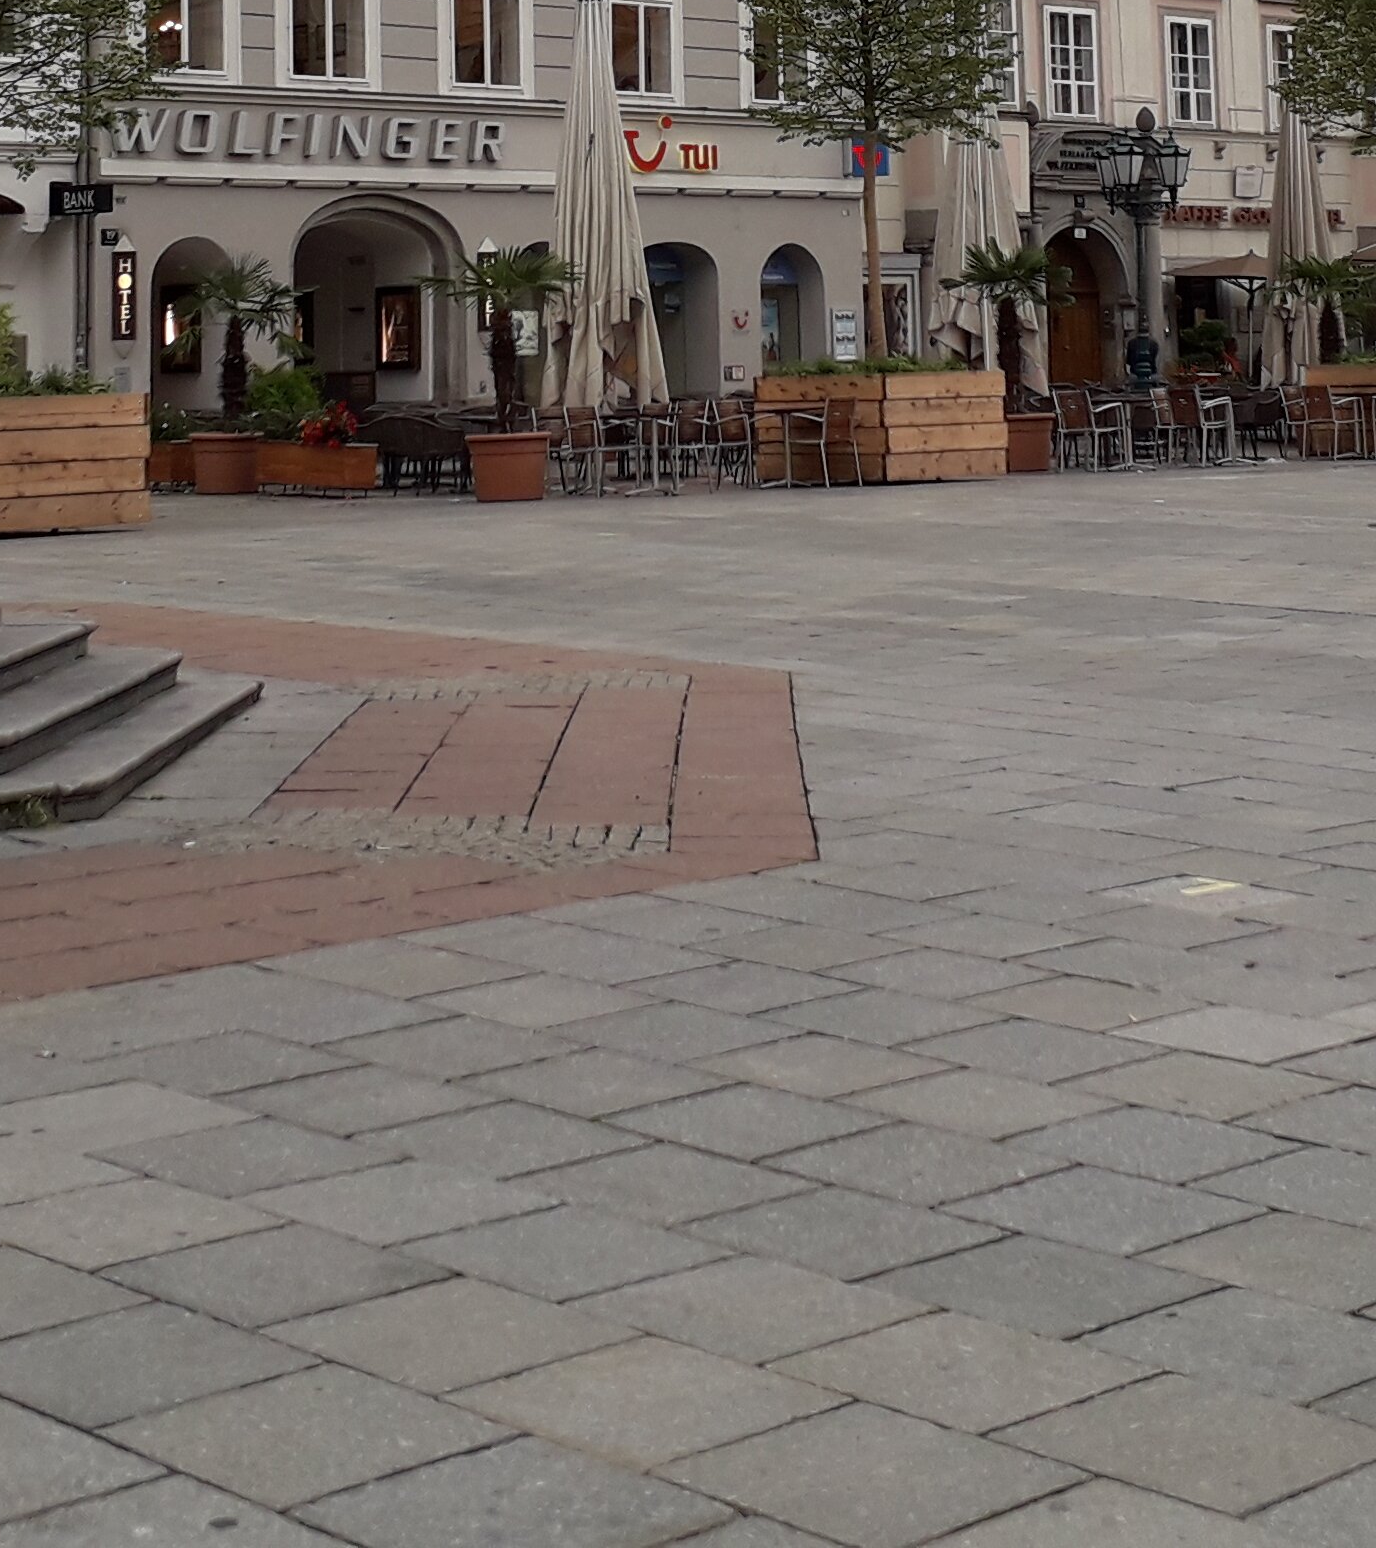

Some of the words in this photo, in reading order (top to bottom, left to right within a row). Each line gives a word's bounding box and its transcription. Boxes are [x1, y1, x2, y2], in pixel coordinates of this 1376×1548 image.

[111, 107, 506, 163] WOLFINGER
[679, 143, 719, 172] TUI
[63, 190, 95, 209] BANK
[117, 258, 132, 335] HOTEL
